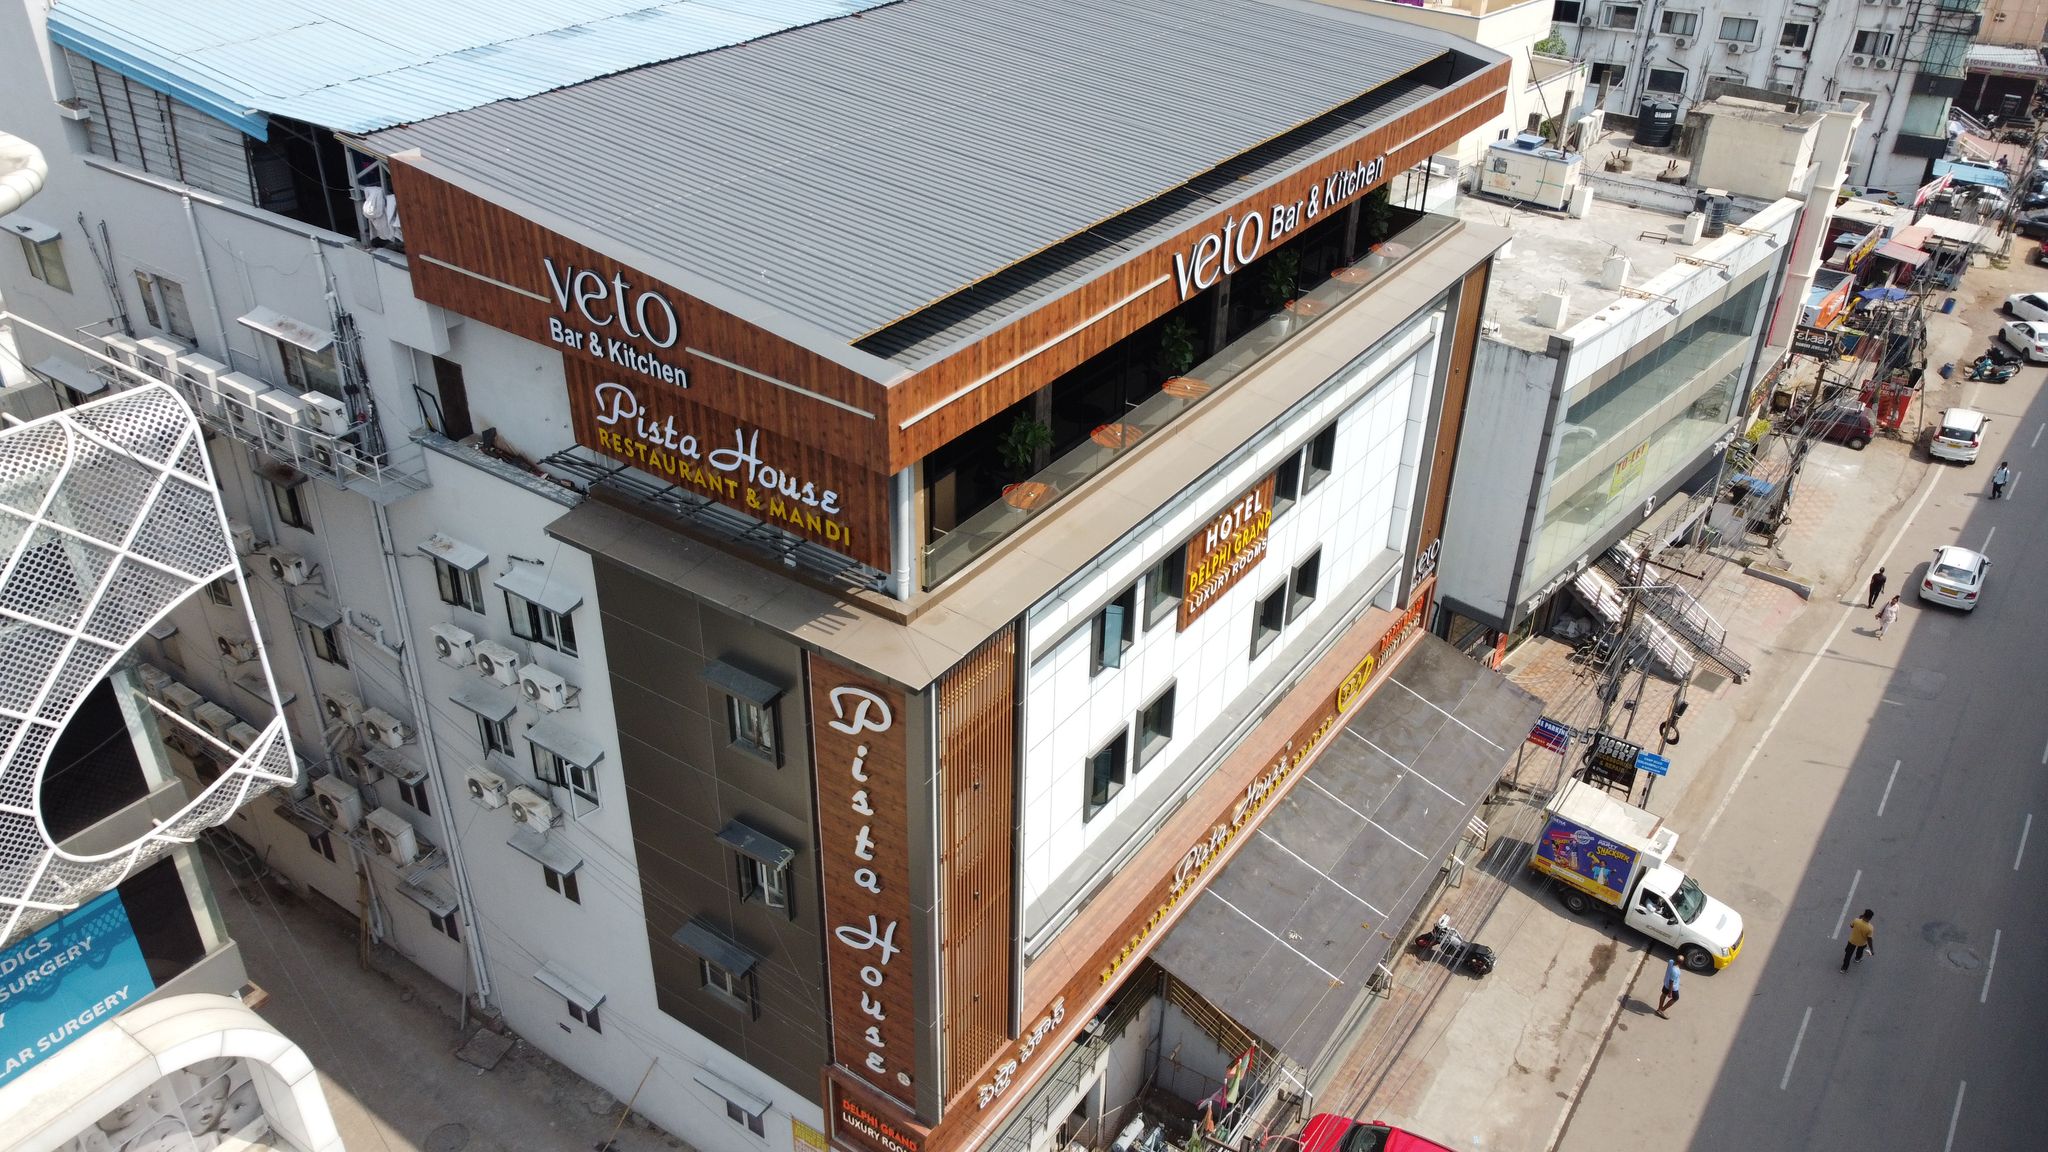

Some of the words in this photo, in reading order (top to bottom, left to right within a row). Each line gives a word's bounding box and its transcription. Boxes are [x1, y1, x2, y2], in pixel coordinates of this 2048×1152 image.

[1271, 200, 1303, 241] Bar
[1307, 184, 1319, 219] &
[1324, 155, 1385, 210] Kitchen
[549, 317, 583, 350] Bar
[589, 331, 604, 358] &
[607, 337, 688, 389] Kitchen
[594, 382, 701, 460] Pista
[708, 427, 840, 515] House
[598, 428, 738, 500] RESTAURANT
[746, 487, 762, 510] &
[769, 499, 850, 546] MANDI
[1189, 542, 1232, 593] DELPHI
[1234, 510, 1273, 554] GRAND
[1205, 489, 1262, 554] HOTEL
[1189, 567, 1231, 614] LUXURY
[1231, 537, 1268, 577] ROOMS
[1599, 736, 1638, 756] MOBILE
[829, 686, 892, 894] Pista
[1169, 823, 1227, 894] Pista
[1232, 755, 1288, 826] House
[0, 937, 52, 978] DICS
[0, 935, 92, 1003] SURGERY
[835, 914, 900, 1074] House
[0, 1047, 35, 1079] AR
[37, 985, 129, 1052] SURGERY
[842, 1099, 878, 1129] DELPHI
[880, 1123, 917, 1151] GRAND
[842, 1111, 880, 1141] LUXURY
